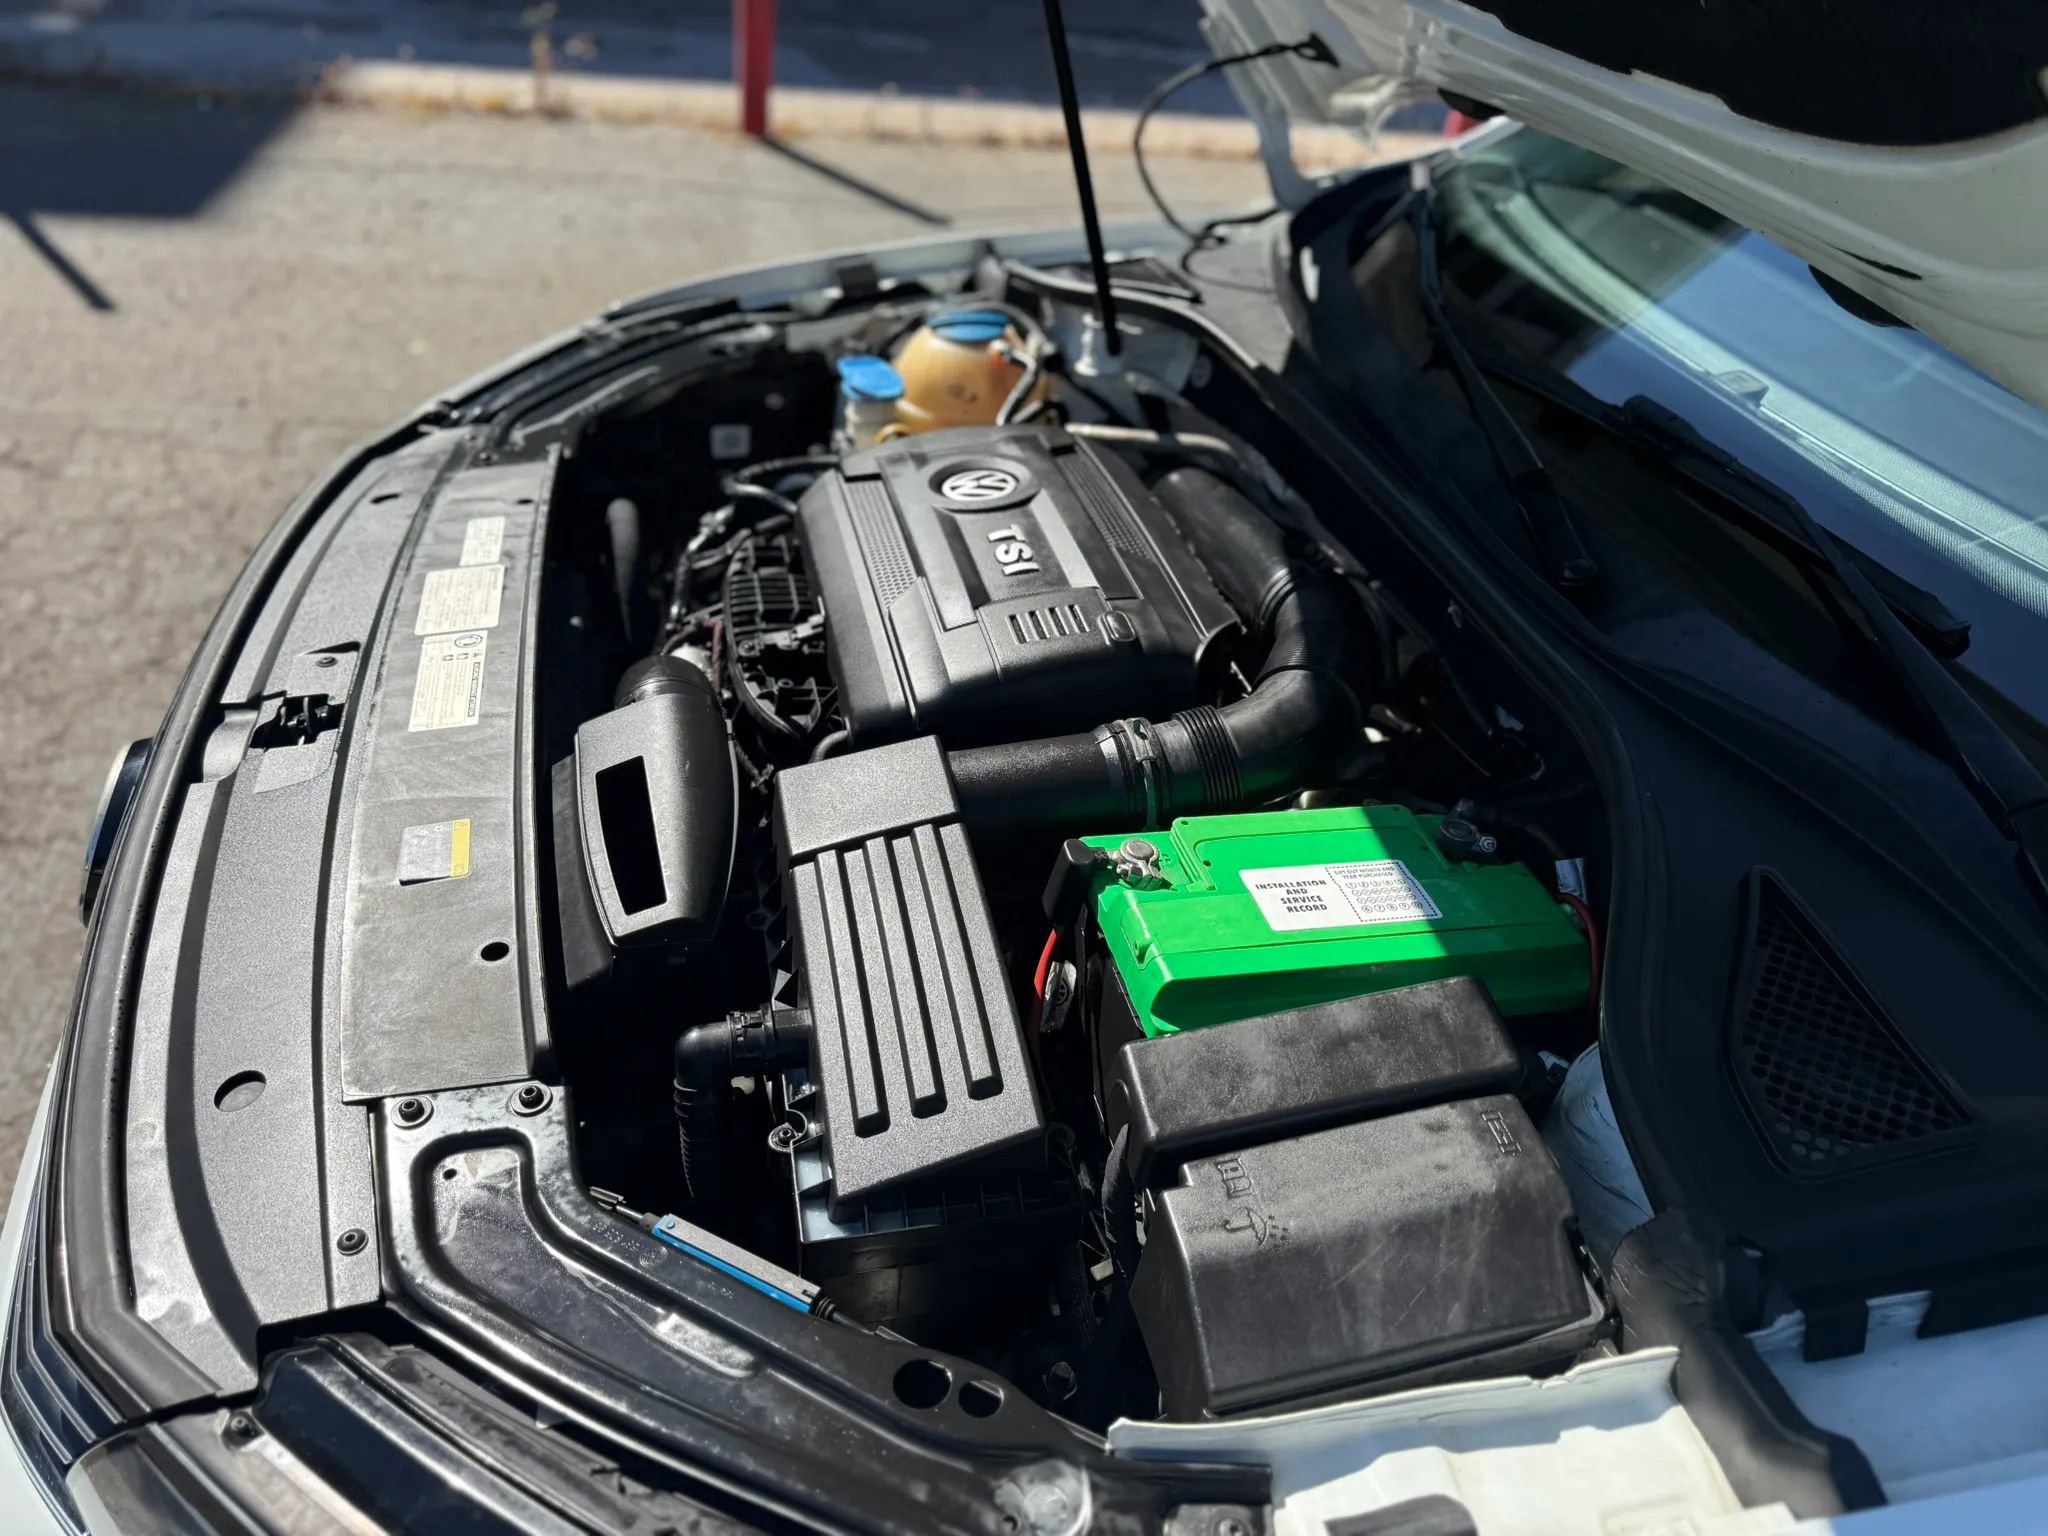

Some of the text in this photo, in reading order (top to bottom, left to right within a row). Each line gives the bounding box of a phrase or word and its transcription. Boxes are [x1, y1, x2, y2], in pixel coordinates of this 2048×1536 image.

[987, 523, 1040, 576] TSI
[1255, 880, 1328, 890] INSTALLATION
[1286, 888, 1308, 896] AND
[1280, 895, 1324, 904] SERVICE
[1286, 904, 1328, 913] RECORD
